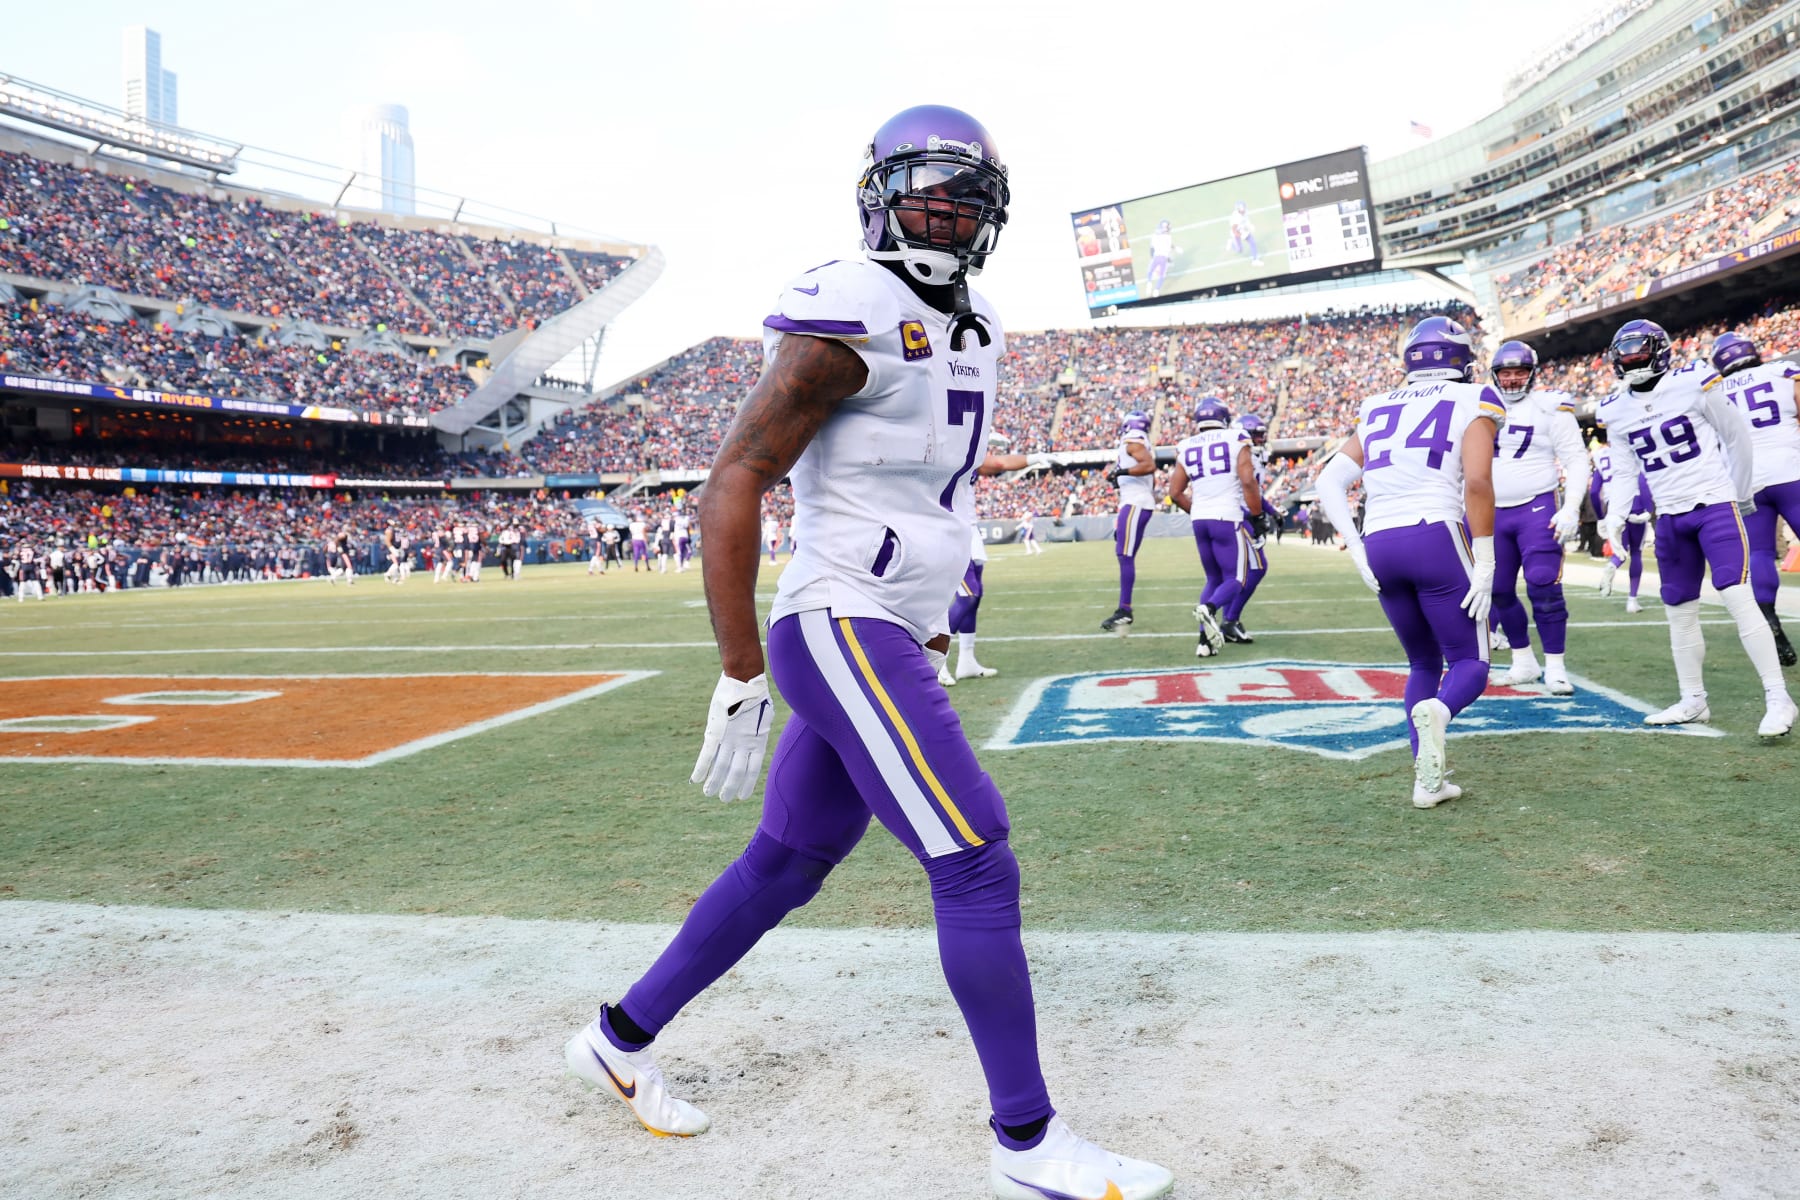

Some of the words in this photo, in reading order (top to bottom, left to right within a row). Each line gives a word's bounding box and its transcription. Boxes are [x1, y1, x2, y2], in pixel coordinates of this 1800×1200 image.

[1294, 178, 1323, 195] PNC
[901, 321, 928, 350] C
[132, 389, 212, 408] BETRIVERS
[940, 389, 984, 512] 7
[1363, 400, 1456, 471] 24
[1628, 415, 1701, 472] 29
[1185, 441, 1231, 481] 99
